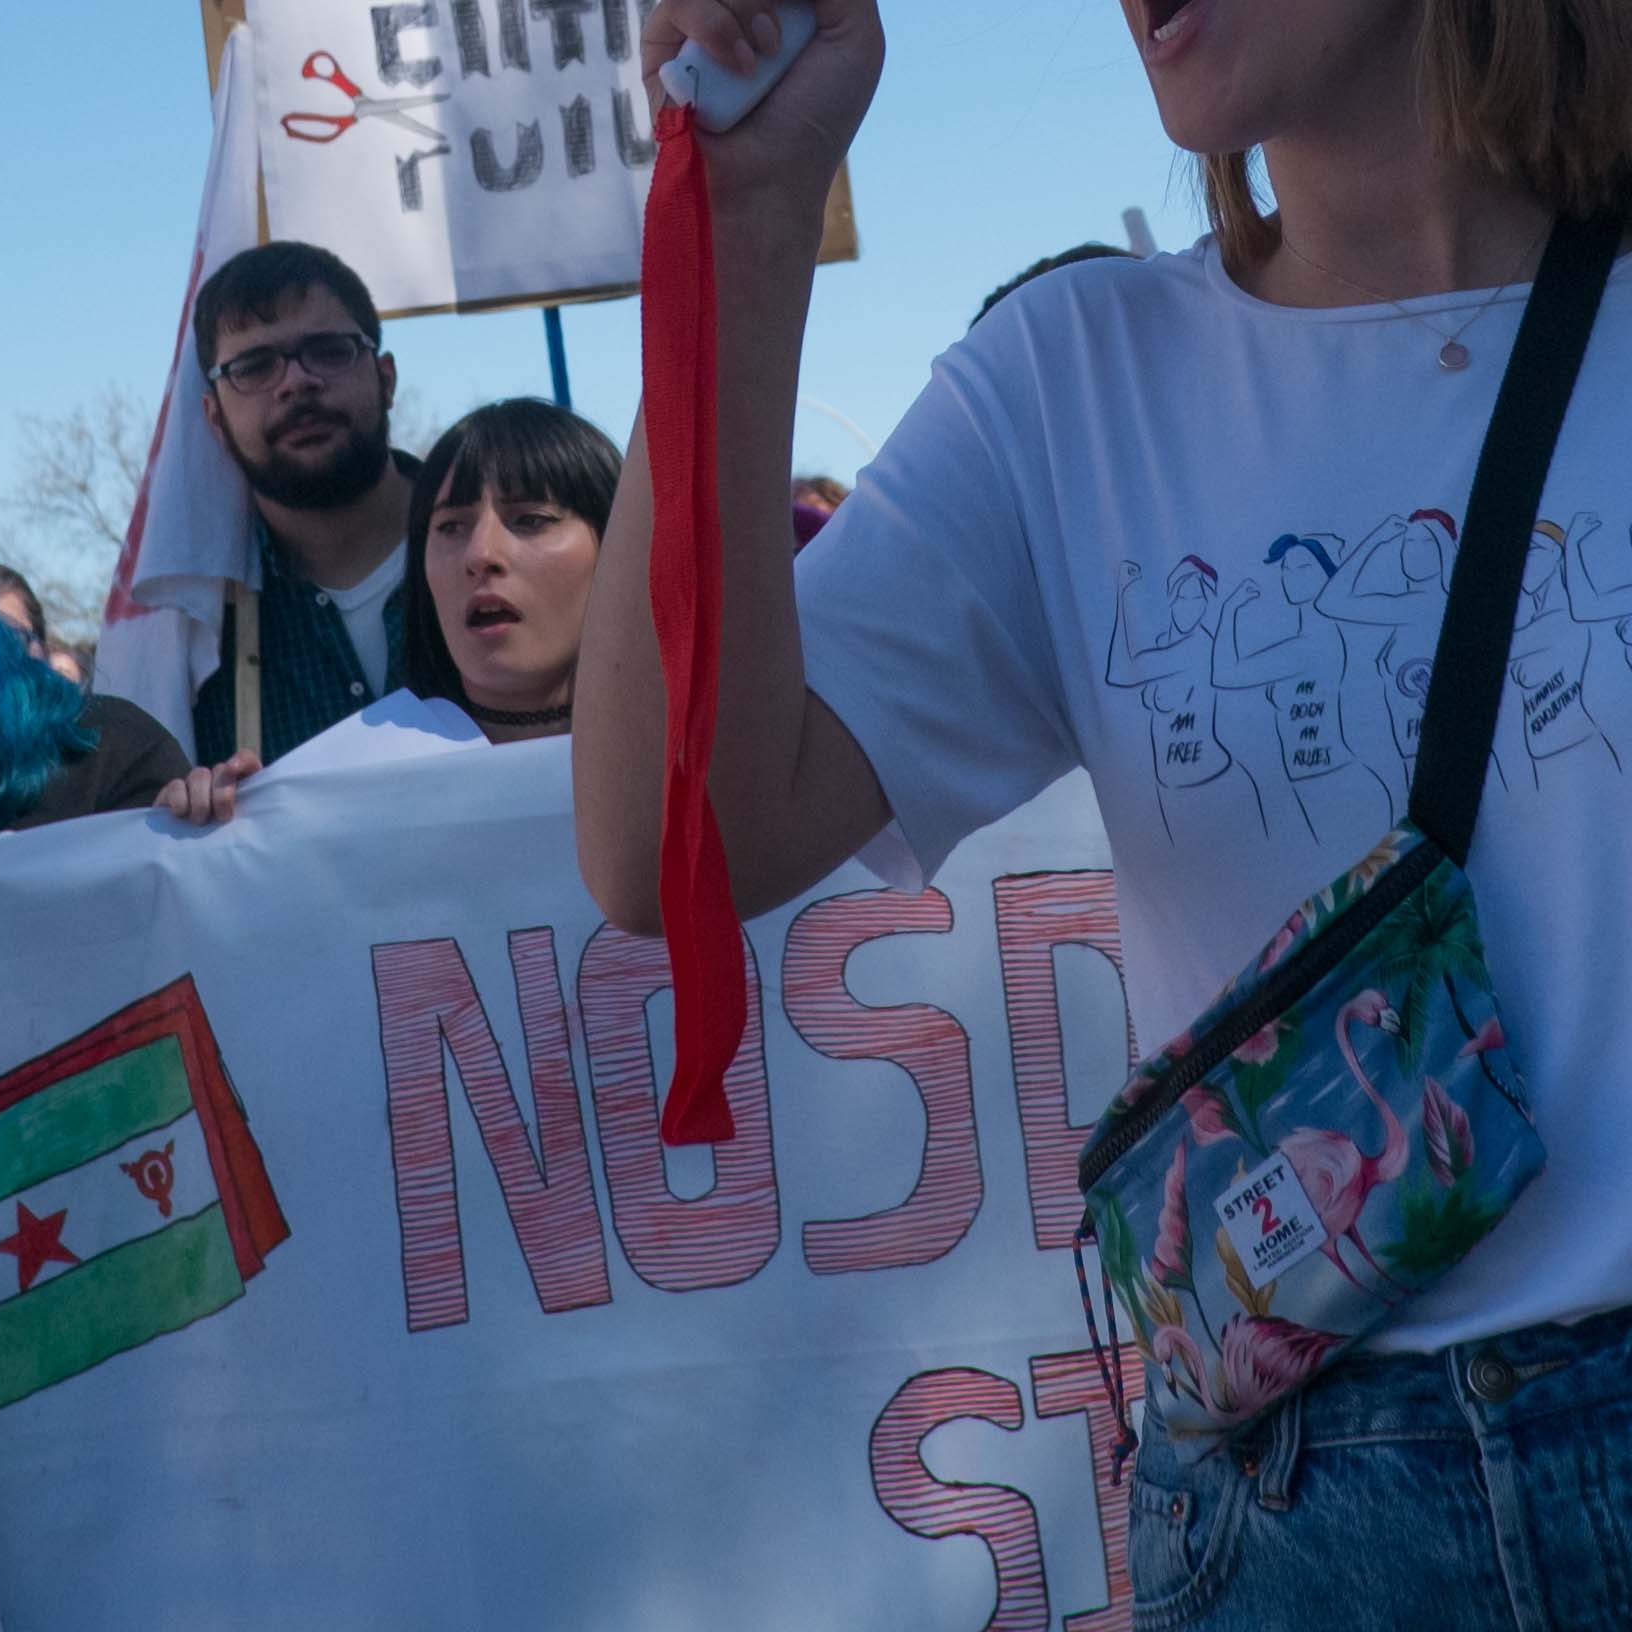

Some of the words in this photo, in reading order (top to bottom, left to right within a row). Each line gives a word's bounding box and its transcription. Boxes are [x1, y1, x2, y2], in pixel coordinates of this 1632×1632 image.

[1289, 701, 1325, 722] BODY
[1522, 667, 1566, 716] FEMINIST
[1529, 680, 1582, 735] REVOLUTION
[1170, 712, 1196, 733] AM
[1166, 739, 1203, 765] FREE
[1293, 747, 1331, 767] RULES
[1223, 1165, 1286, 1220] STREET
[1251, 1194, 1282, 1236] 2
[1252, 1215, 1303, 1260] HOME
